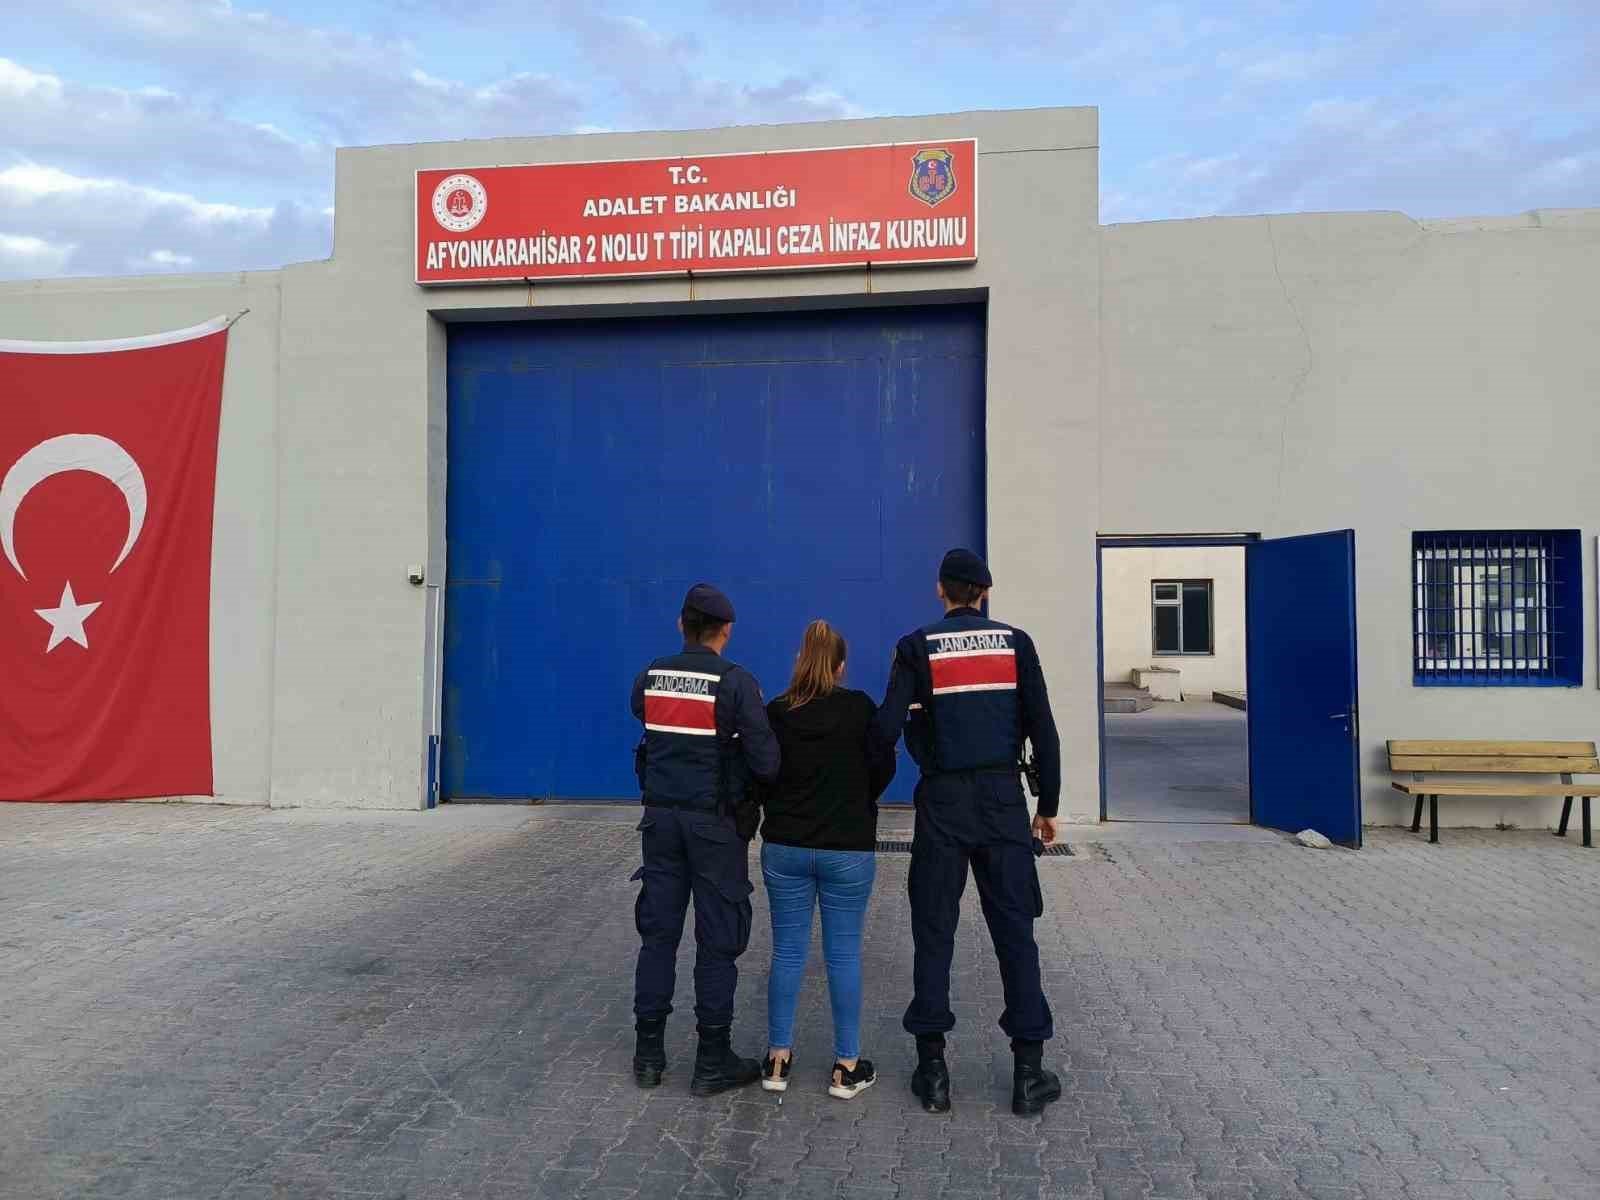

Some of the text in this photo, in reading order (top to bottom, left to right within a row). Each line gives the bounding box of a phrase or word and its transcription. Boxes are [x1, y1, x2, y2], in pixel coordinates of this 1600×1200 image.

[668, 165, 708, 185] T.C.
[583, 185, 797, 217] ADALET BAKANLIĞI
[426, 216, 967, 269] AFYONKARAHİSAR 2 NOLU T TİPİ KAPALI CEZA İNFAZ KURUMU
[936, 634, 1009, 653] JANDARMA
[651, 675, 709, 695] JANDARMA
